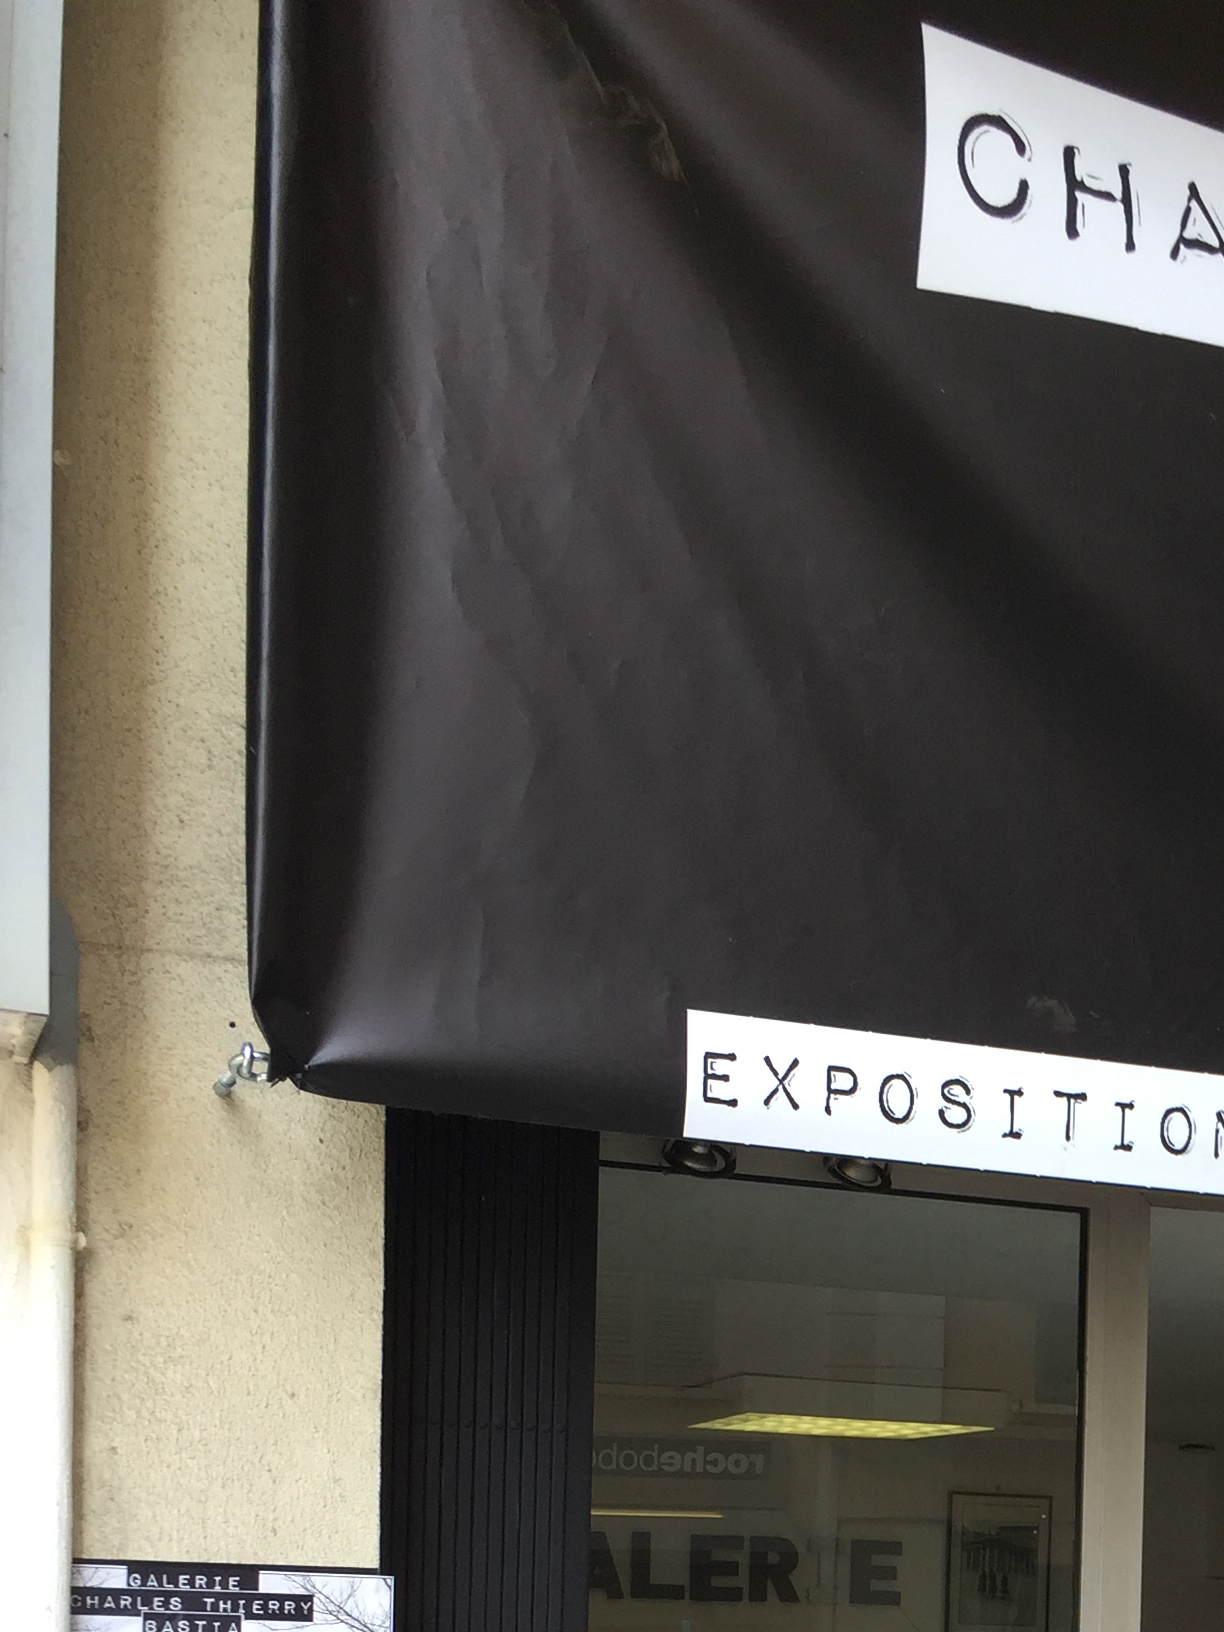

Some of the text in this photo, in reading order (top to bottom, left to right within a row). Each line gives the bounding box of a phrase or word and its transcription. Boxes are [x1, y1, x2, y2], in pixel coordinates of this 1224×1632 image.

[129, 1573, 240, 1590] GALERIE
[70, 1594, 311, 1614] CHARLES THIERRY
